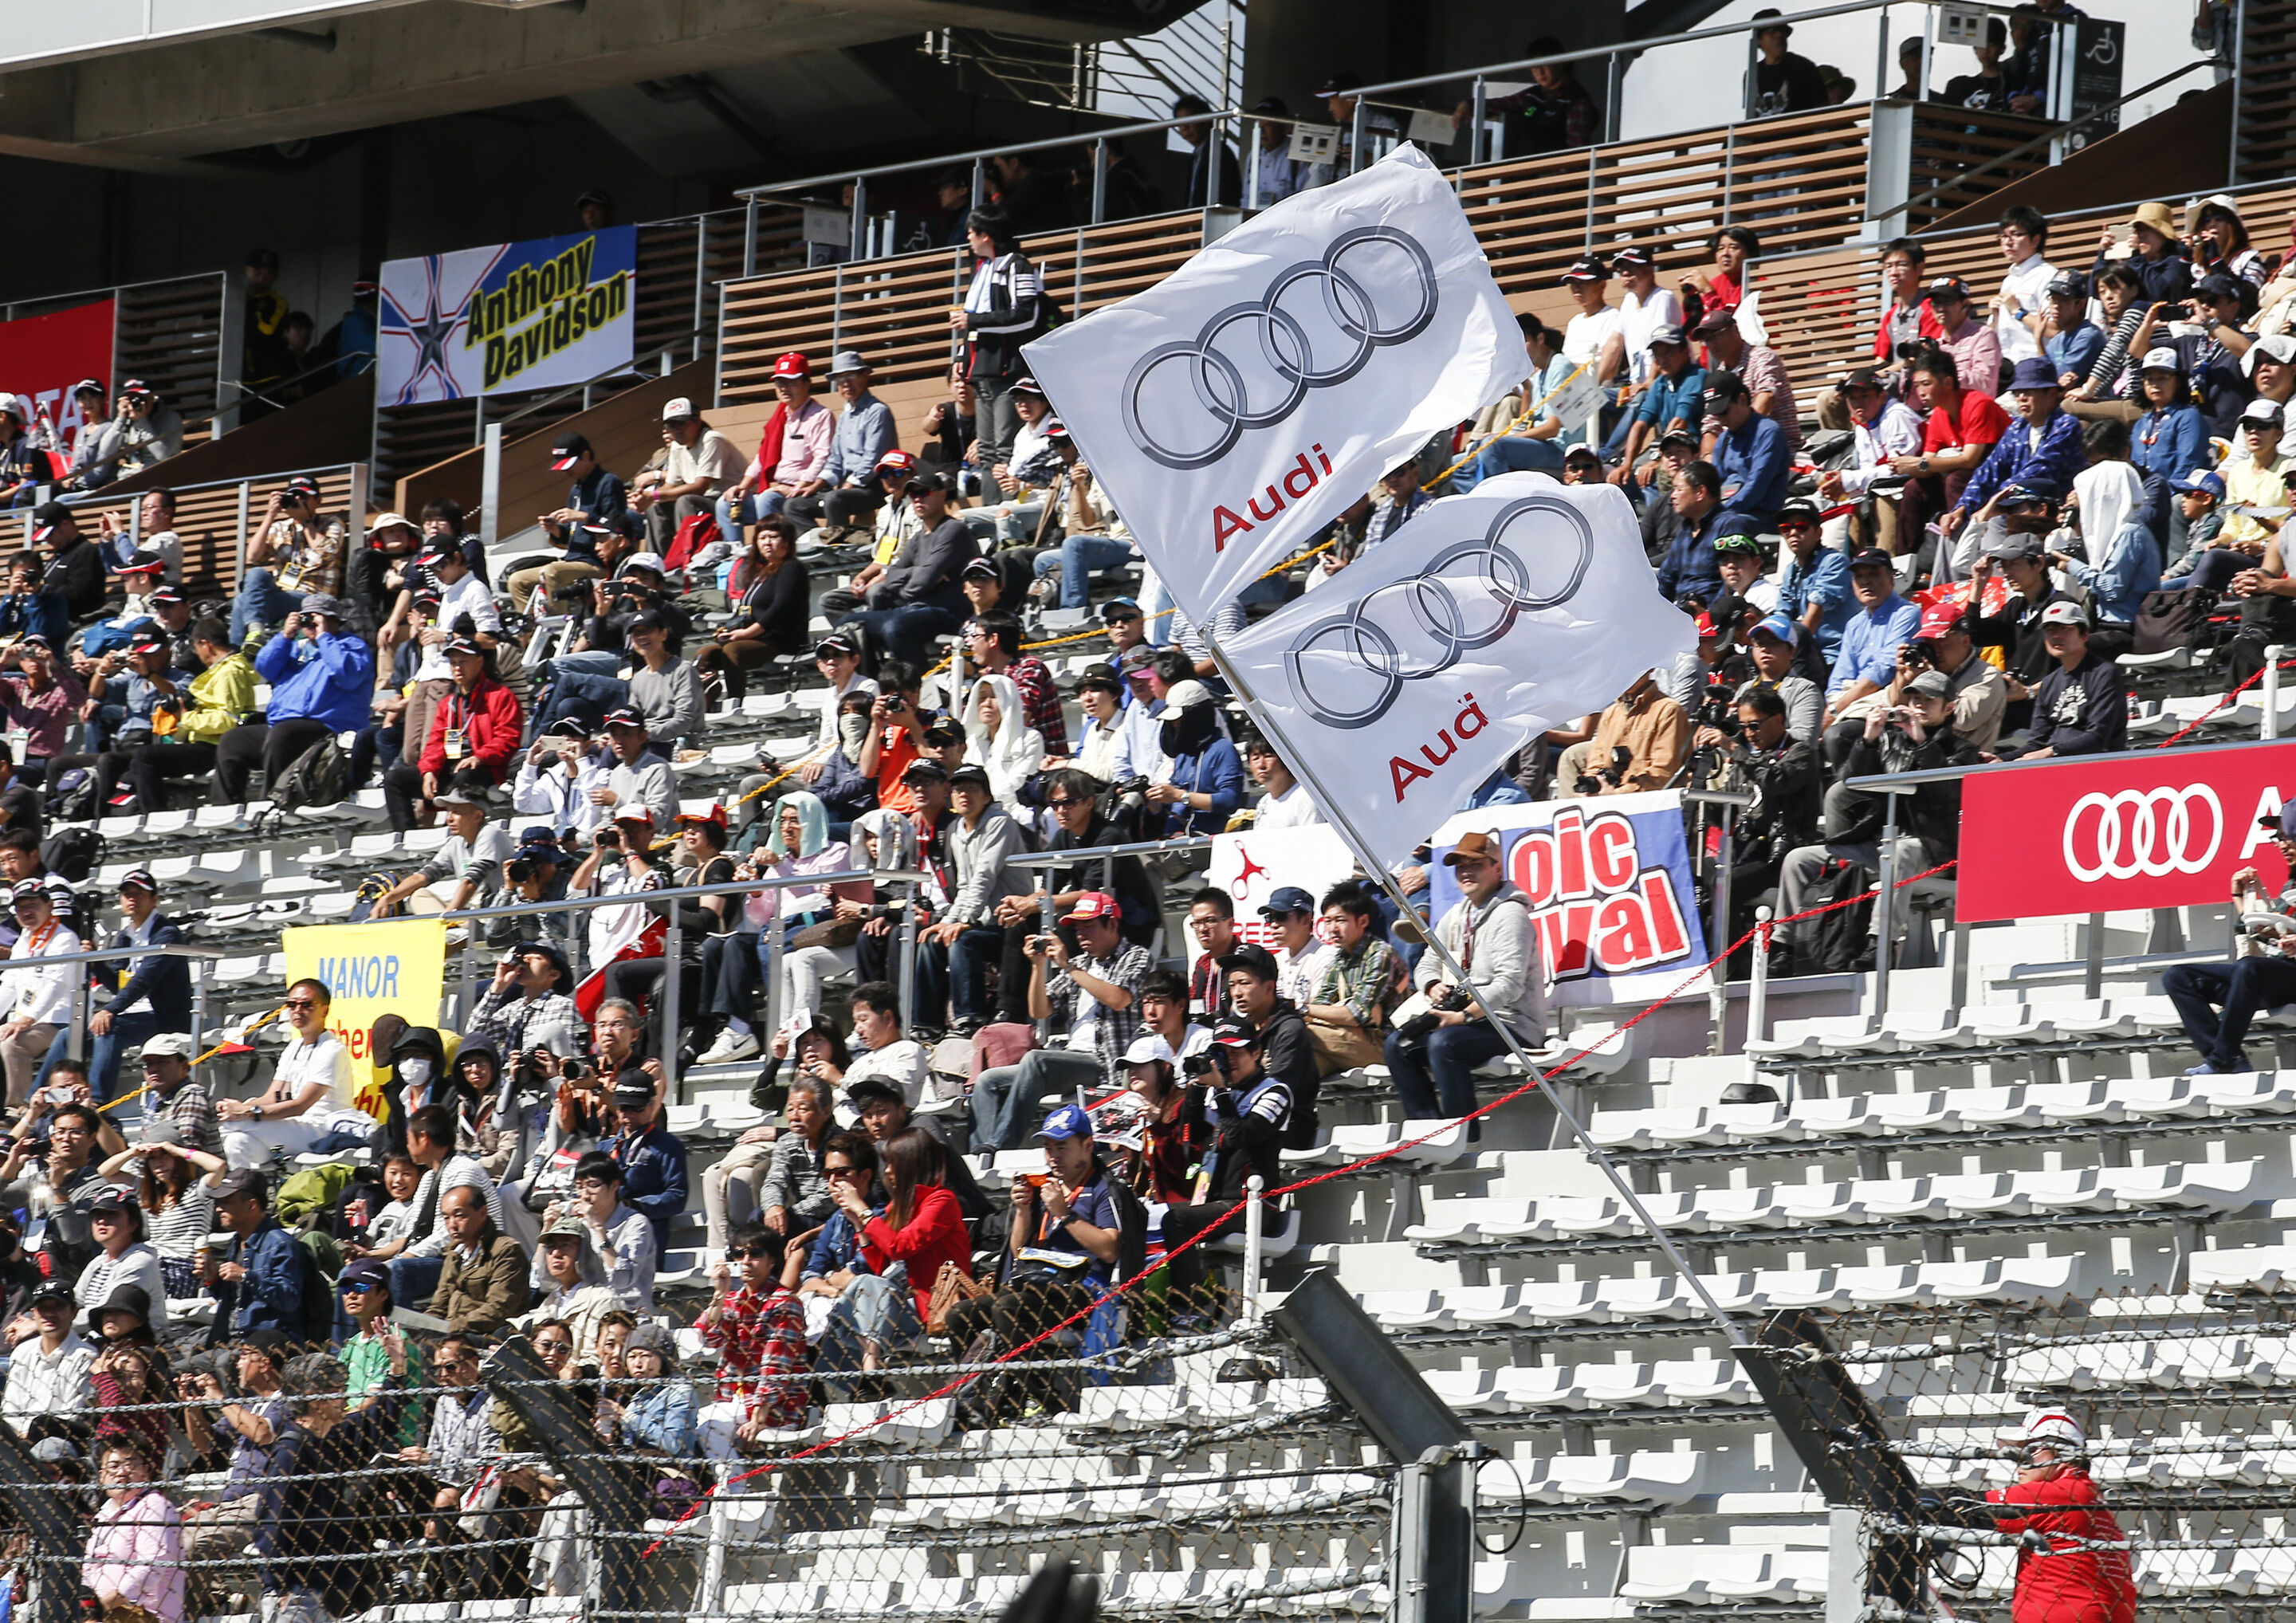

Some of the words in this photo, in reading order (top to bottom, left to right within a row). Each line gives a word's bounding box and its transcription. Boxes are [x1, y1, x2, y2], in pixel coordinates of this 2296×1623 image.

[465, 234, 596, 351] Anthony
[482, 268, 627, 392] Davidson
[1212, 442, 1333, 553] Audi
[1492, 807, 1639, 910] oic
[319, 954, 399, 1000] MANOR
